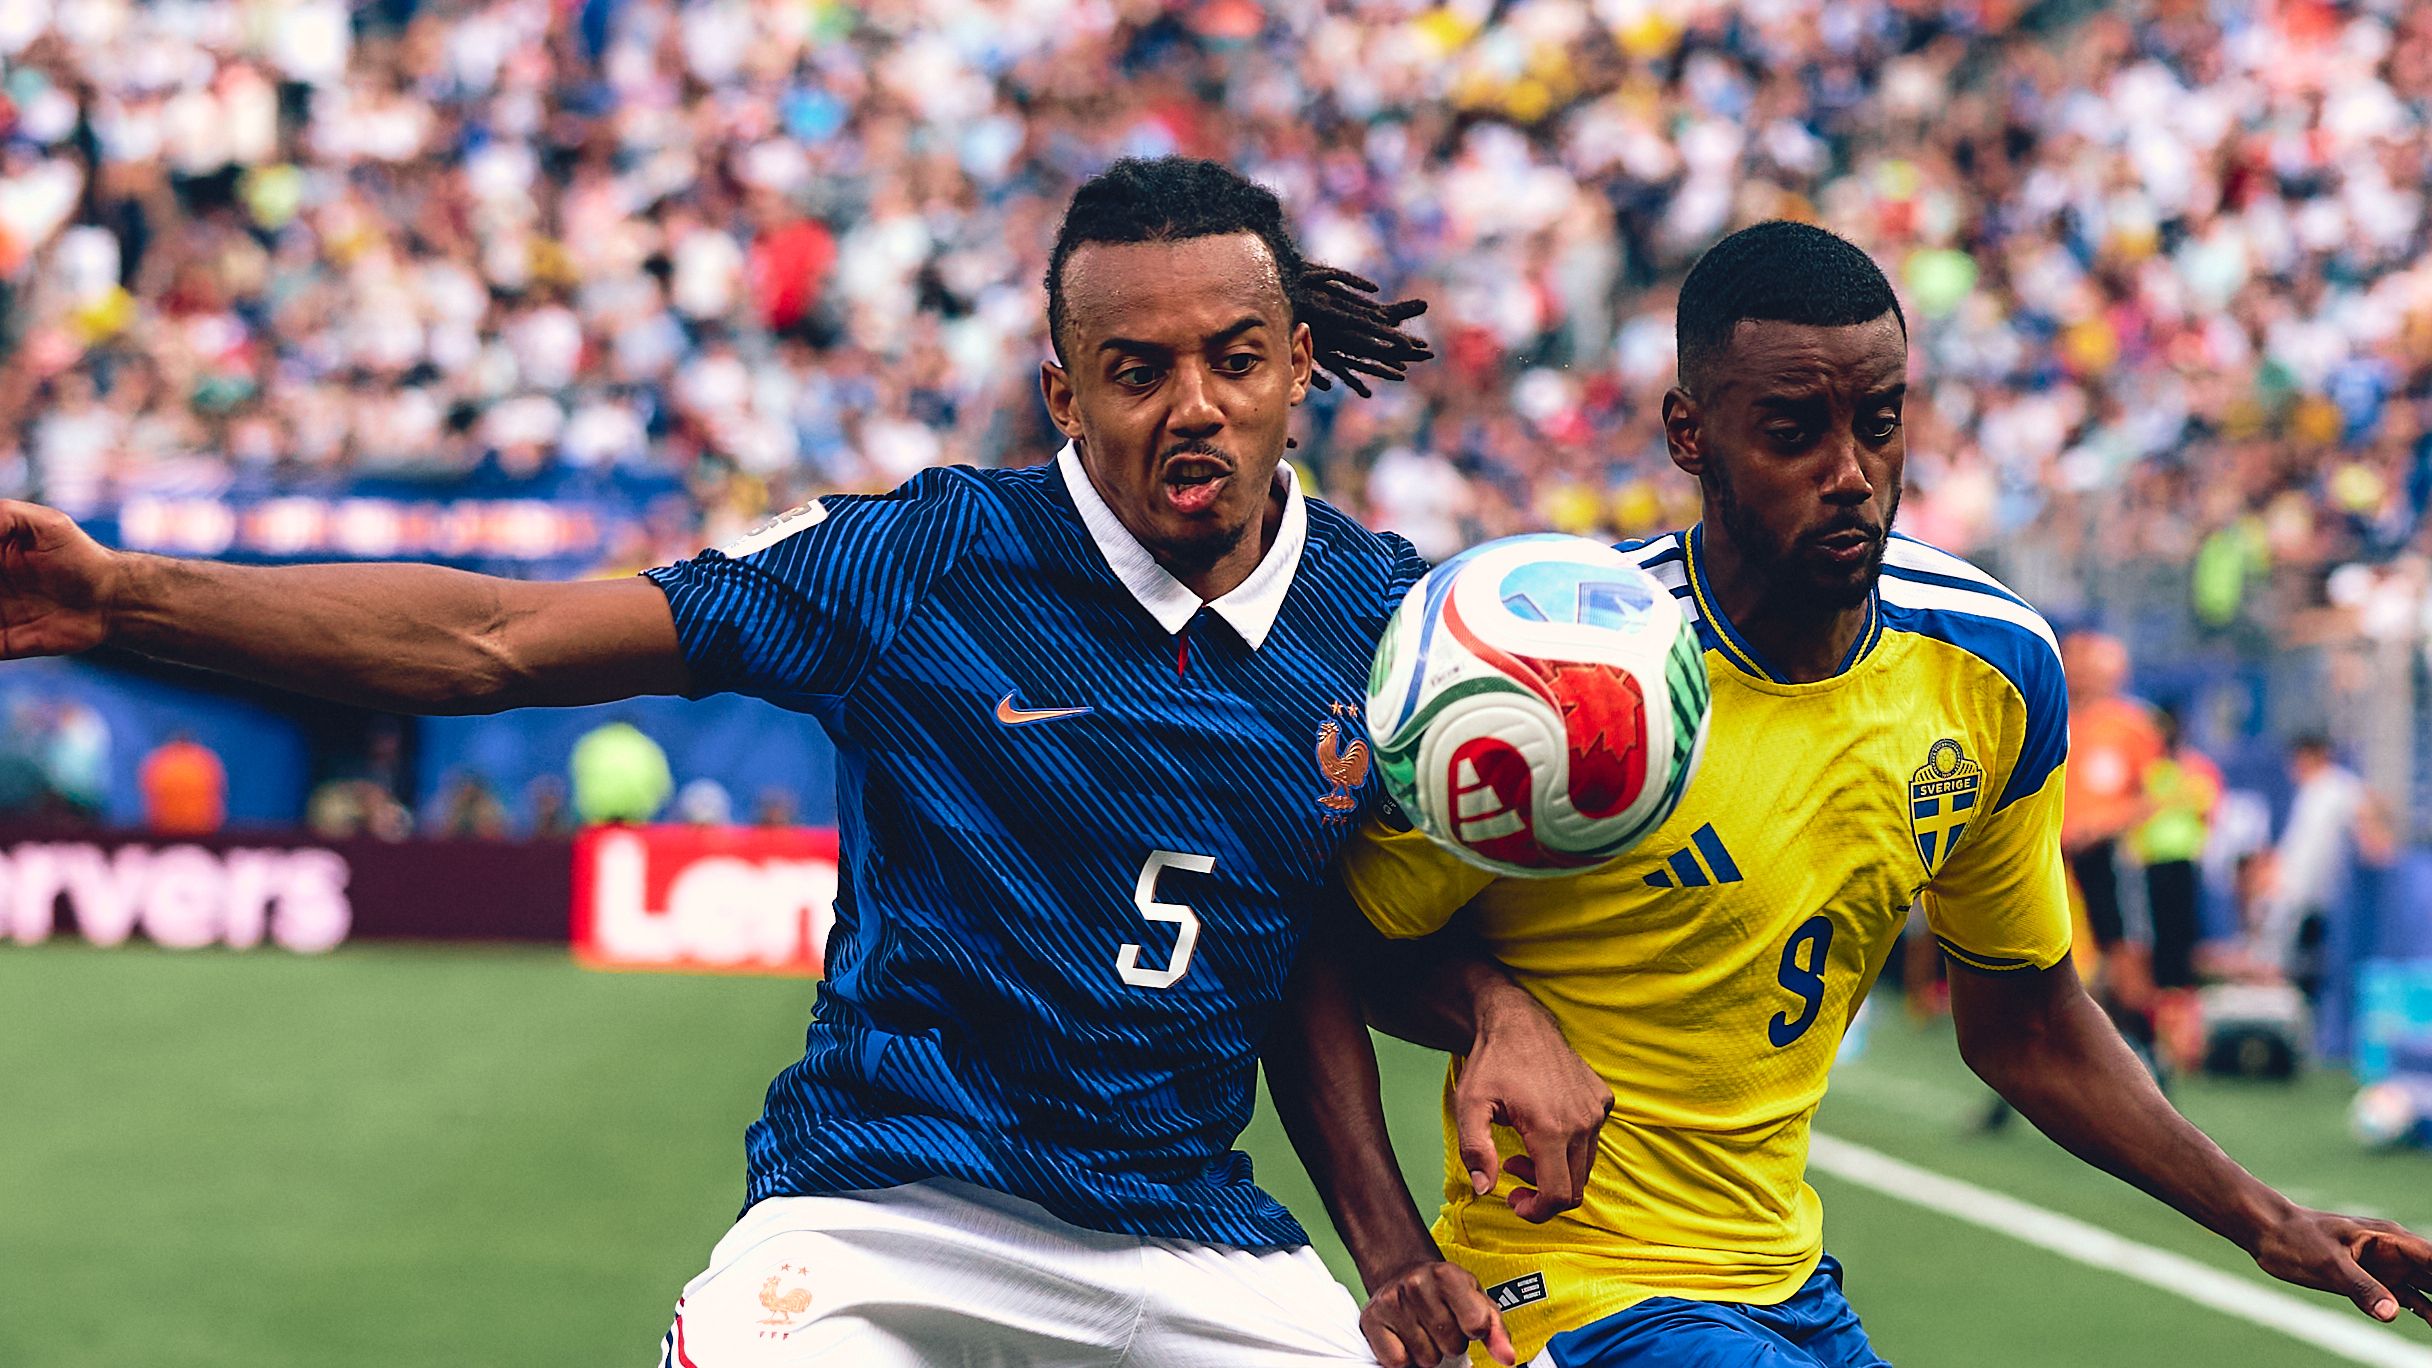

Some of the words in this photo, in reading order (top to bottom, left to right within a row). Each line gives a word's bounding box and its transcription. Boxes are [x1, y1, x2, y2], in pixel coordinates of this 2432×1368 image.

[1919, 777, 1972, 796] SVERIGE
[0, 843, 351, 953] rvers
[1115, 849, 1217, 989] 5
[1767, 915, 1834, 1049] 9
